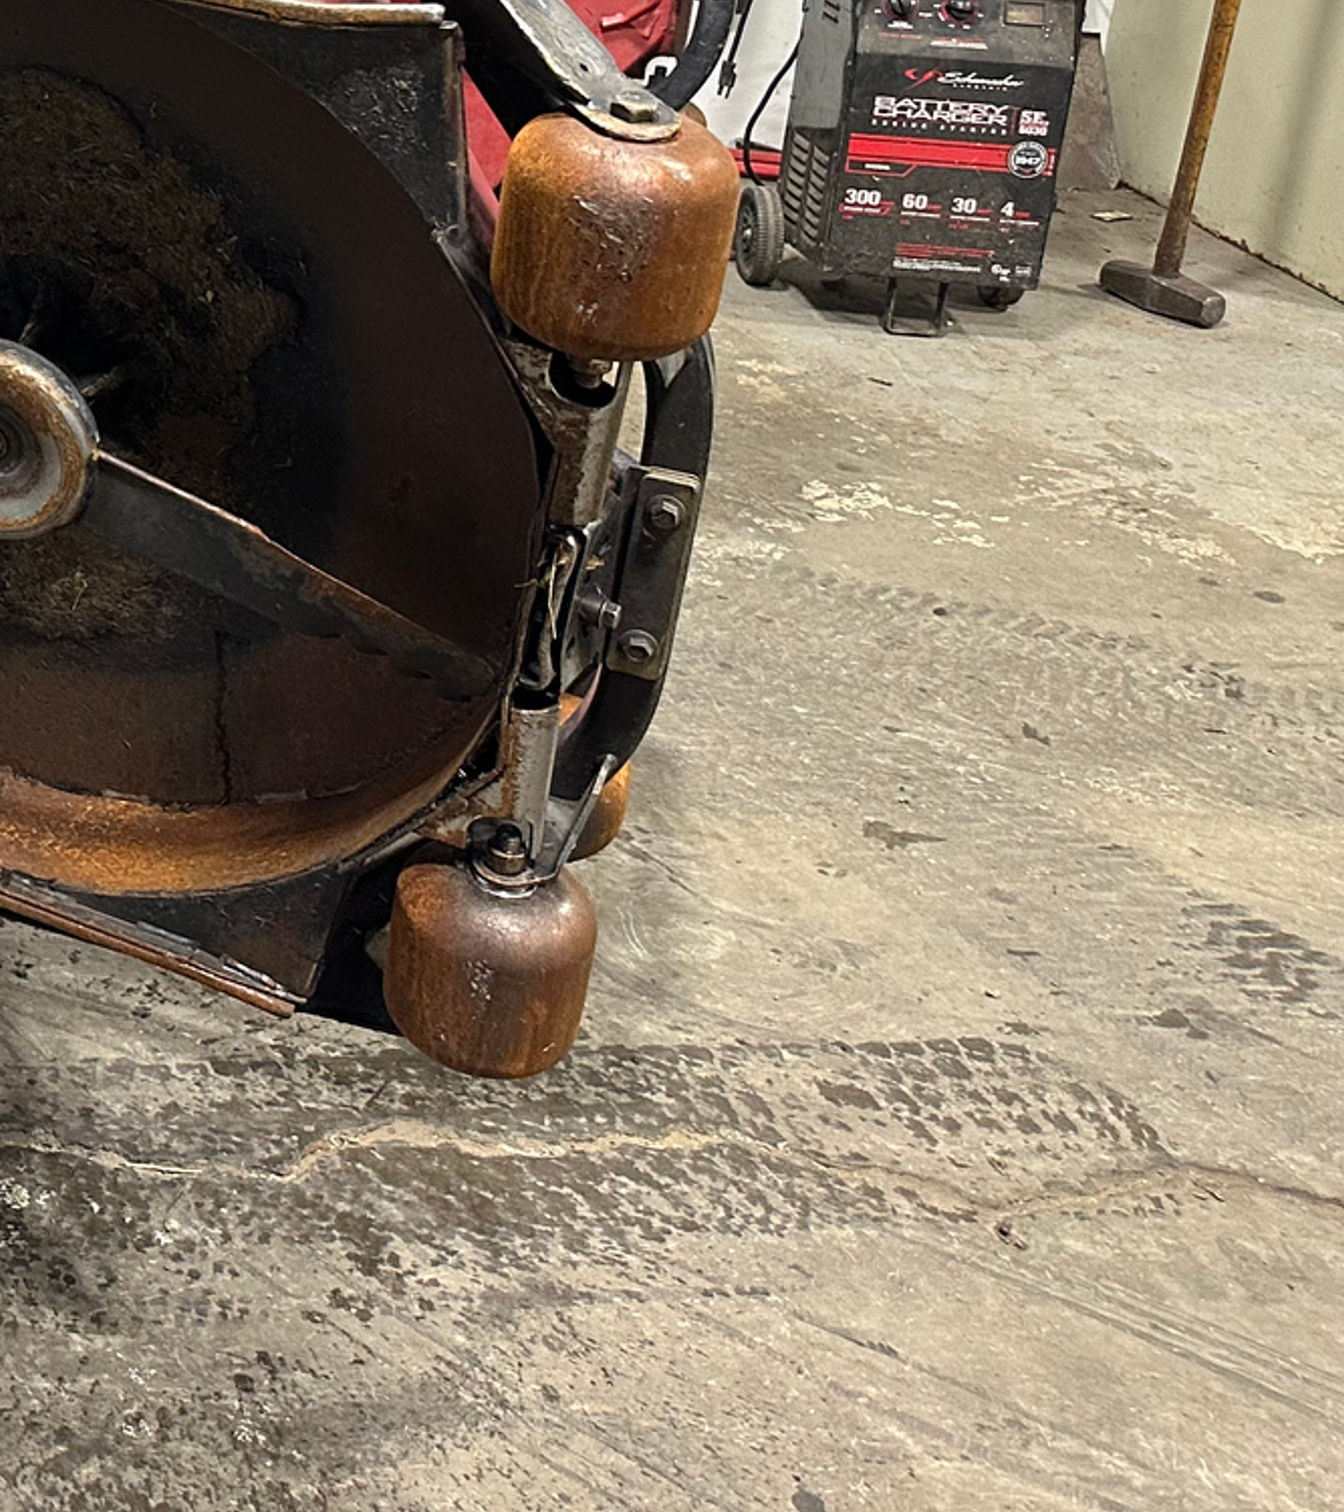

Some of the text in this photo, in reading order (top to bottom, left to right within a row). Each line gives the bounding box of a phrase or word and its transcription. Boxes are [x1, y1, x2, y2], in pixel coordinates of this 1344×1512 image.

[872, 105, 1009, 127] CHARGER
[873, 95, 1011, 115] BATTERY
[844, 188, 882, 206] 300
[902, 193, 929, 211] 60
[951, 197, 978, 214] 30
[1000, 201, 1015, 218] 4
